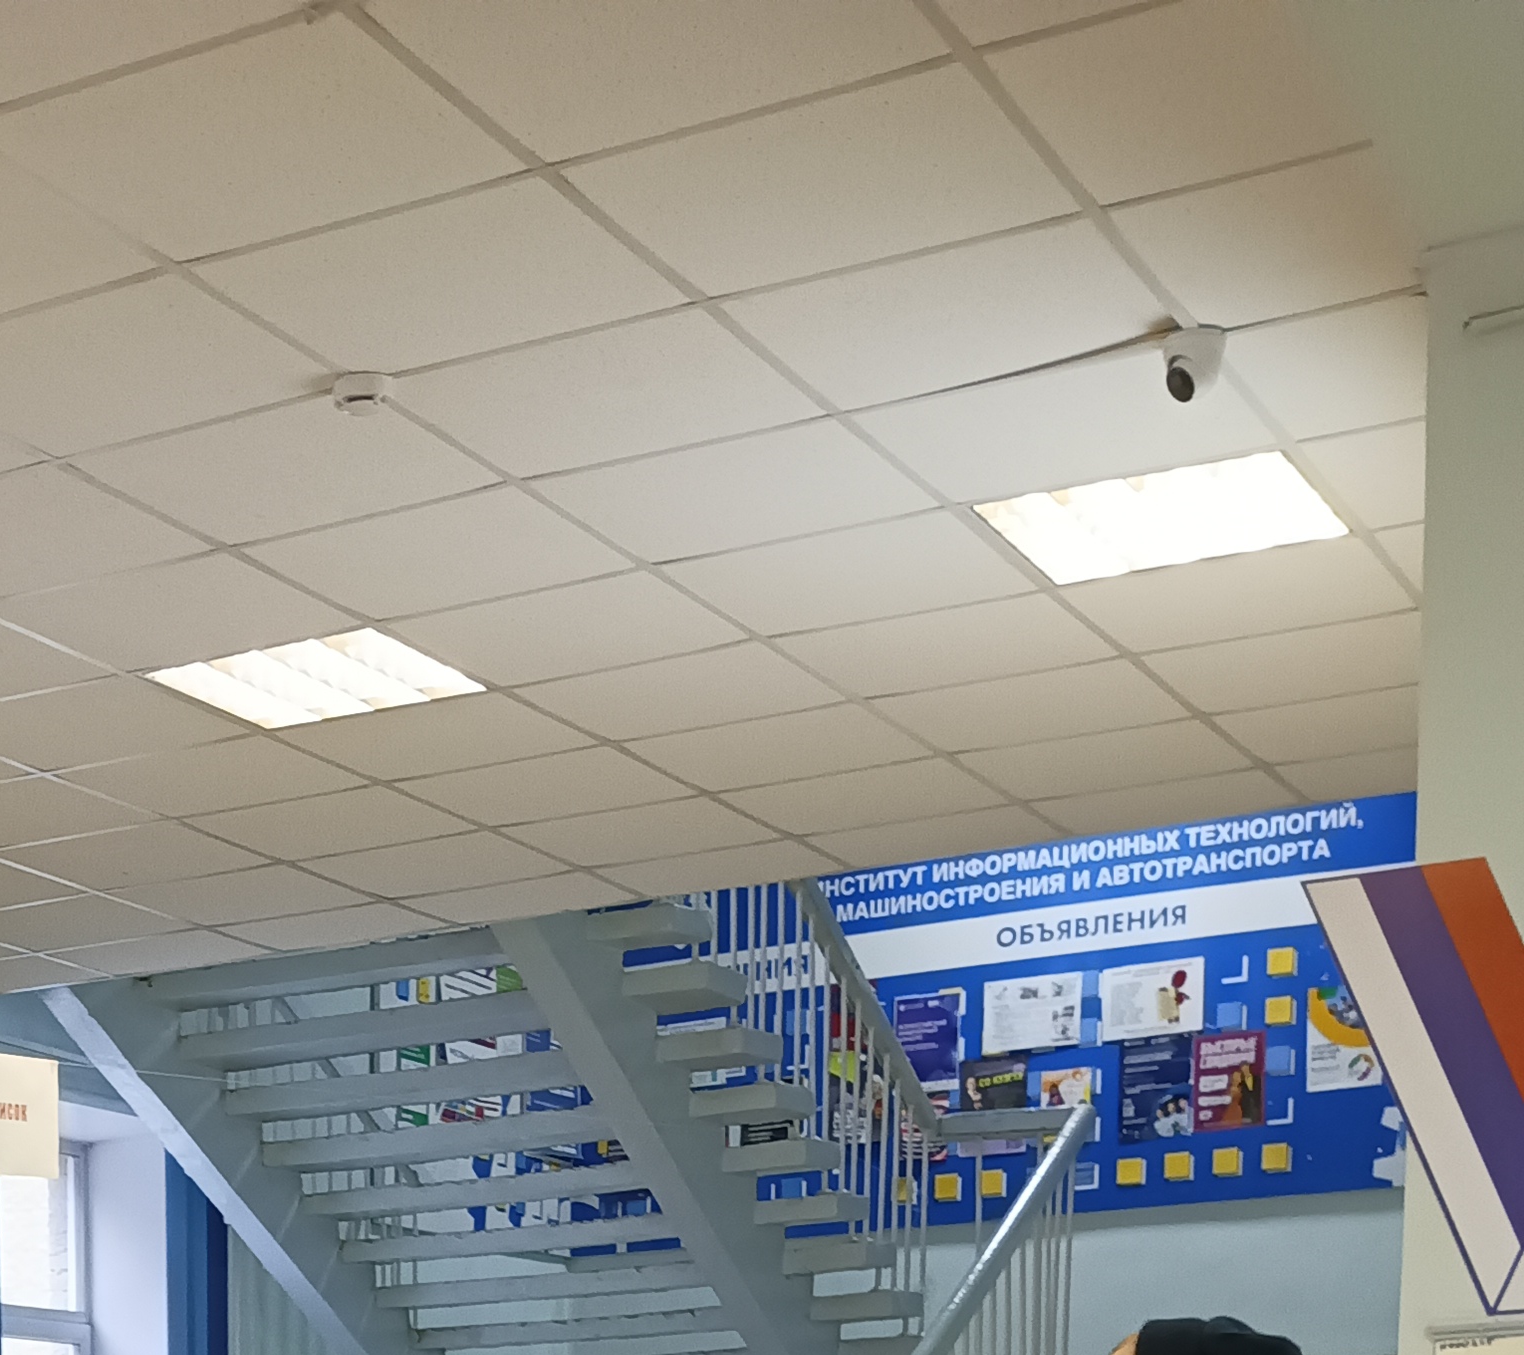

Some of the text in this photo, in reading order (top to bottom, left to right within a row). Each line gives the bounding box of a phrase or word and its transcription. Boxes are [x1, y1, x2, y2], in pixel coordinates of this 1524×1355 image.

[836, 838, 1331, 923] МАШИНОСТРОЕНИЯ И АВТОТРАНСПОРТА
[932, 828, 1180, 882] ИНФОРМАЦИОННЫХ
[1184, 801, 1364, 848] ТЕХНОЛОГИЙ,
[996, 904, 1187, 948] ОБЪЯВЛЕНИЯ
